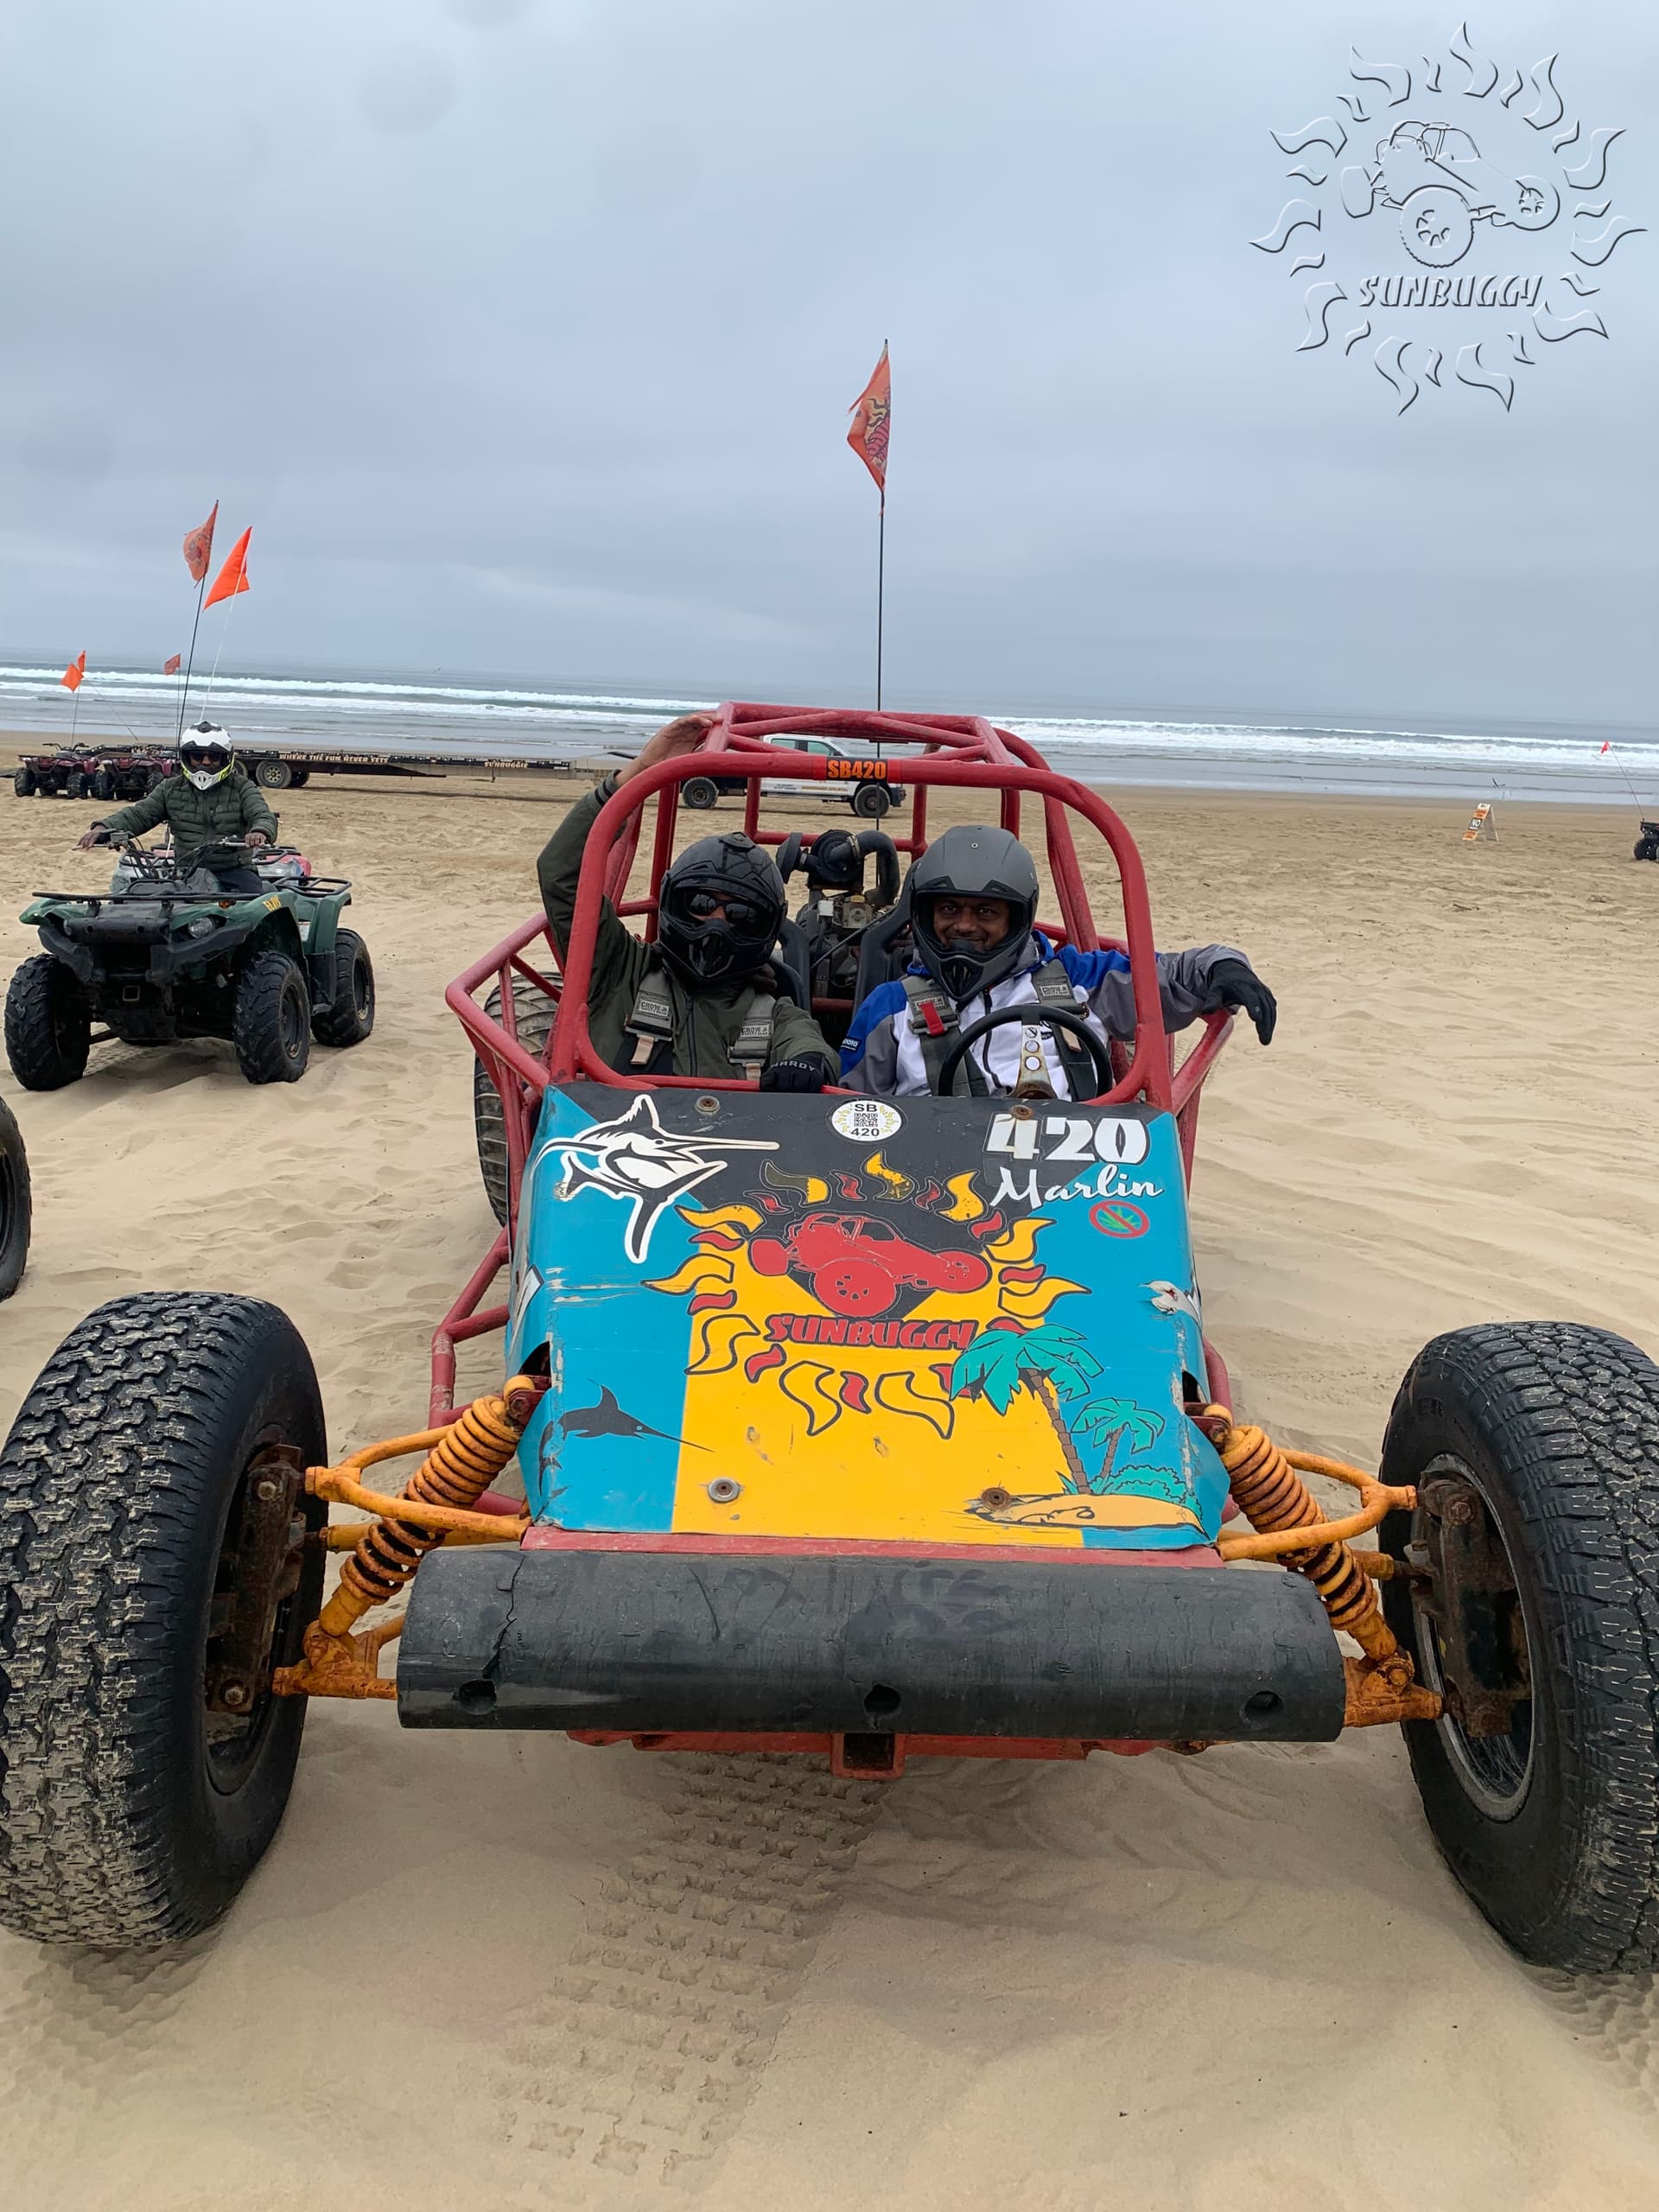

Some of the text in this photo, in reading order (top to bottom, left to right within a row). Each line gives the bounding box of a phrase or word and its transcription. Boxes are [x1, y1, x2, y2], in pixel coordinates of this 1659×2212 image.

[828, 760, 887, 779] SB420
[854, 1103, 878, 1113] SB
[850, 1127, 880, 1138] 420
[986, 1113, 1147, 1164] 420
[989, 1163, 1165, 1210] Marlin
[766, 1314, 977, 1350] SUNBUGGY
